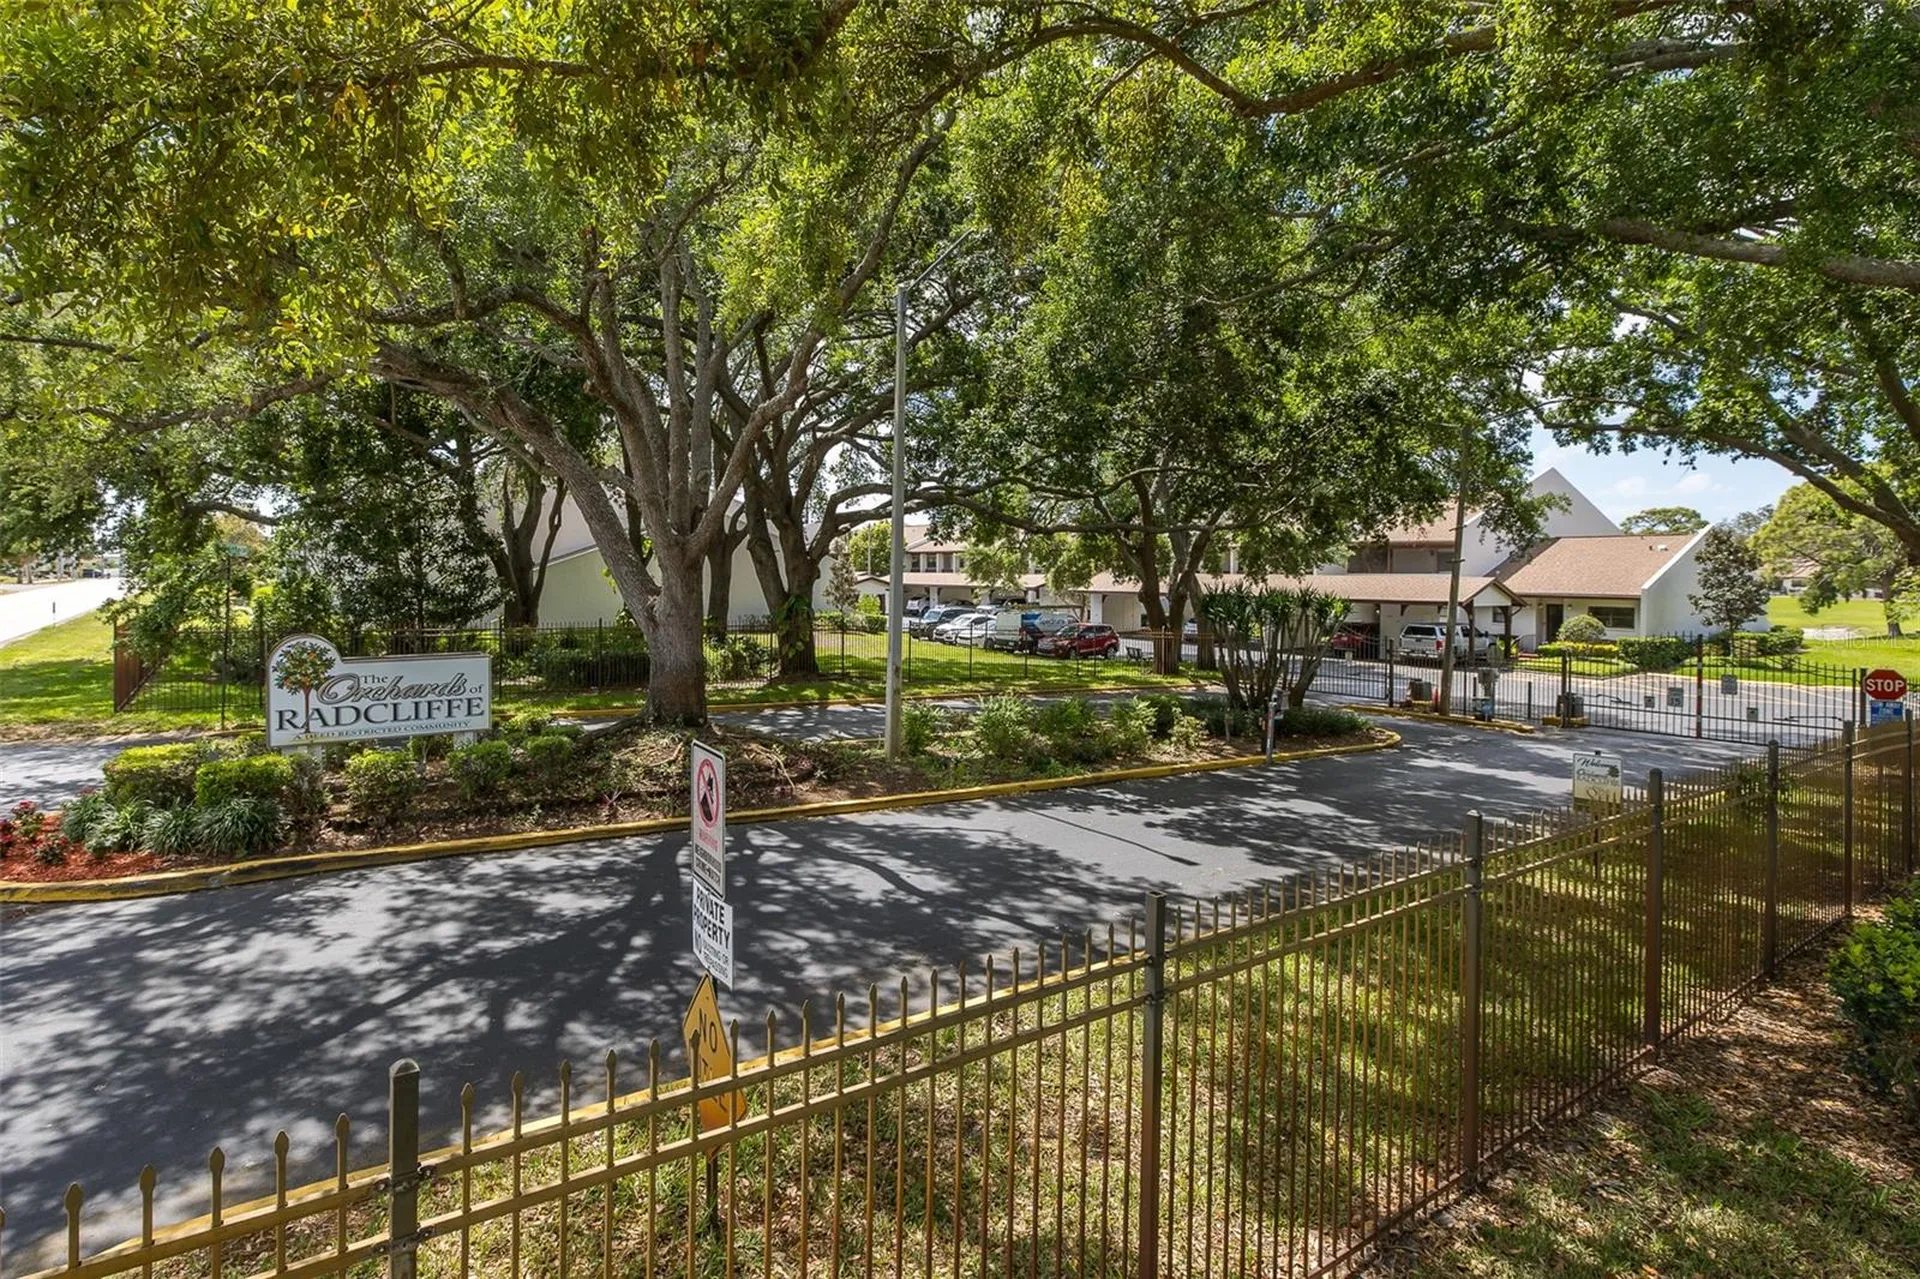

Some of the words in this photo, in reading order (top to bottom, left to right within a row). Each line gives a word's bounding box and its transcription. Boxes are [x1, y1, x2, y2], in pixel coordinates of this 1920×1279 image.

[317, 672, 467, 705] Orchards
[469, 684, 484, 695] of
[361, 674, 388, 684] The
[1866, 678, 1905, 692] STOP
[275, 696, 485, 731] RADCLIFFE
[336, 726, 401, 738] RESTRICTED
[402, 720, 472, 734] COMMUNITY
[696, 886, 725, 924] PRIVATE
[693, 903, 730, 949] PROPERTY
[699, 1008, 718, 1053] NO
